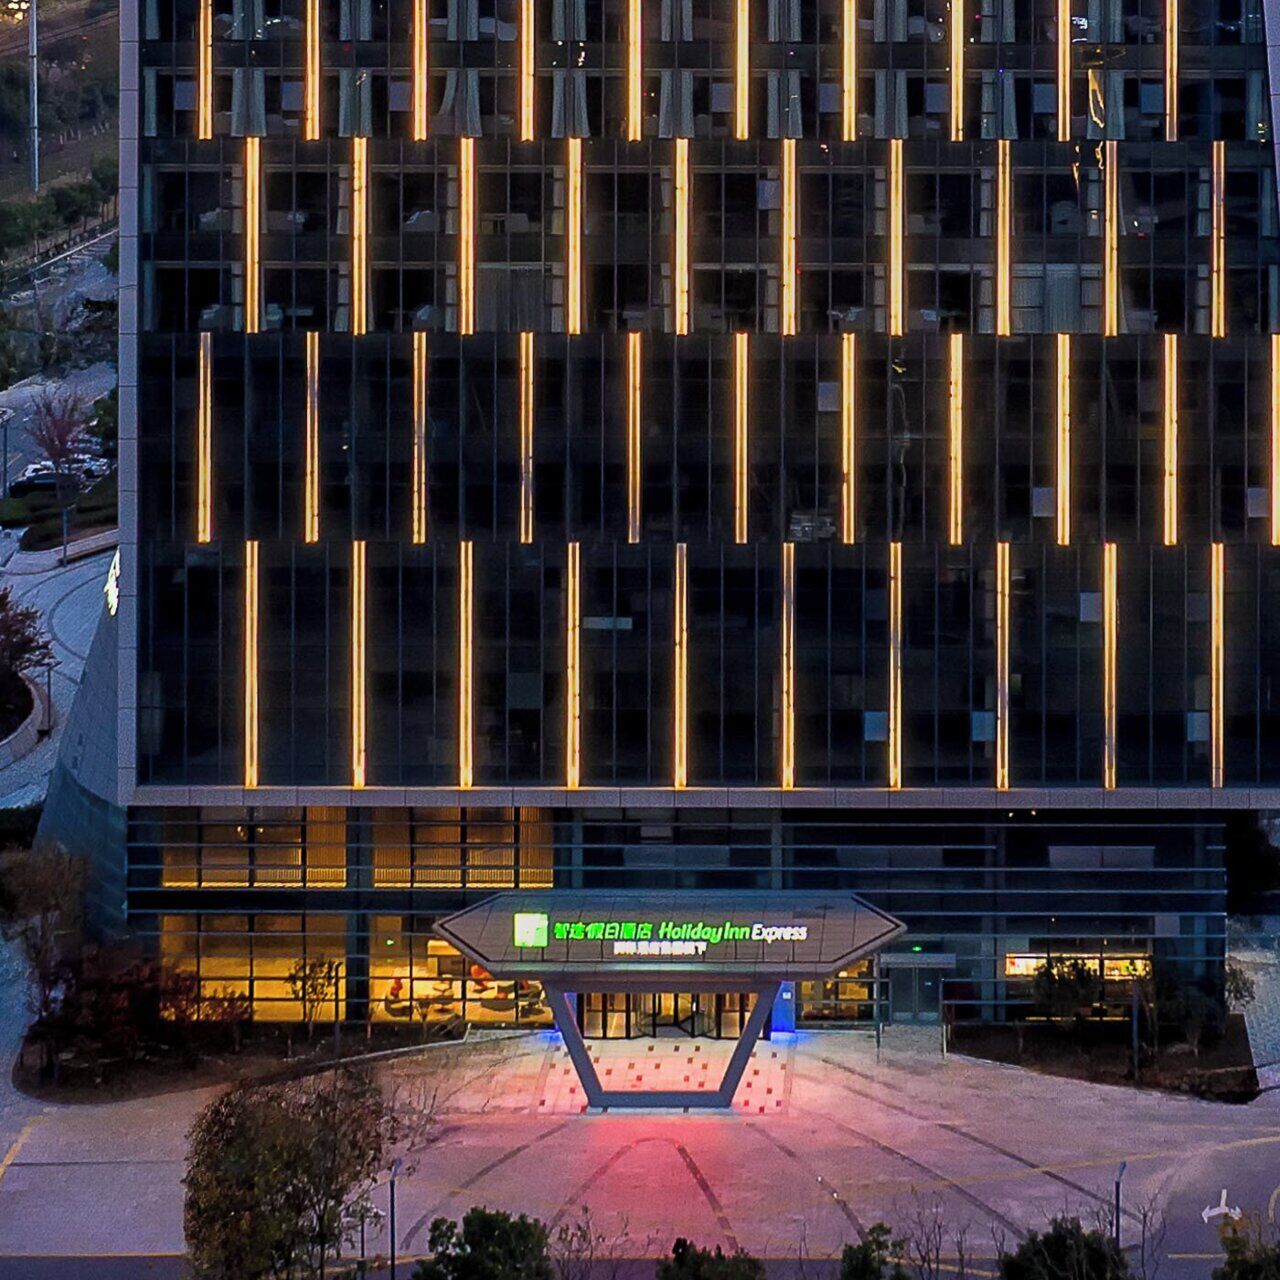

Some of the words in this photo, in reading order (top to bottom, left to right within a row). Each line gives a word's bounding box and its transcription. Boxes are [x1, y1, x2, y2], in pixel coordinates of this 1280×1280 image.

[658, 922, 723, 943] Holiday
[723, 922, 750, 939] Inn
[751, 924, 807, 943] Express
